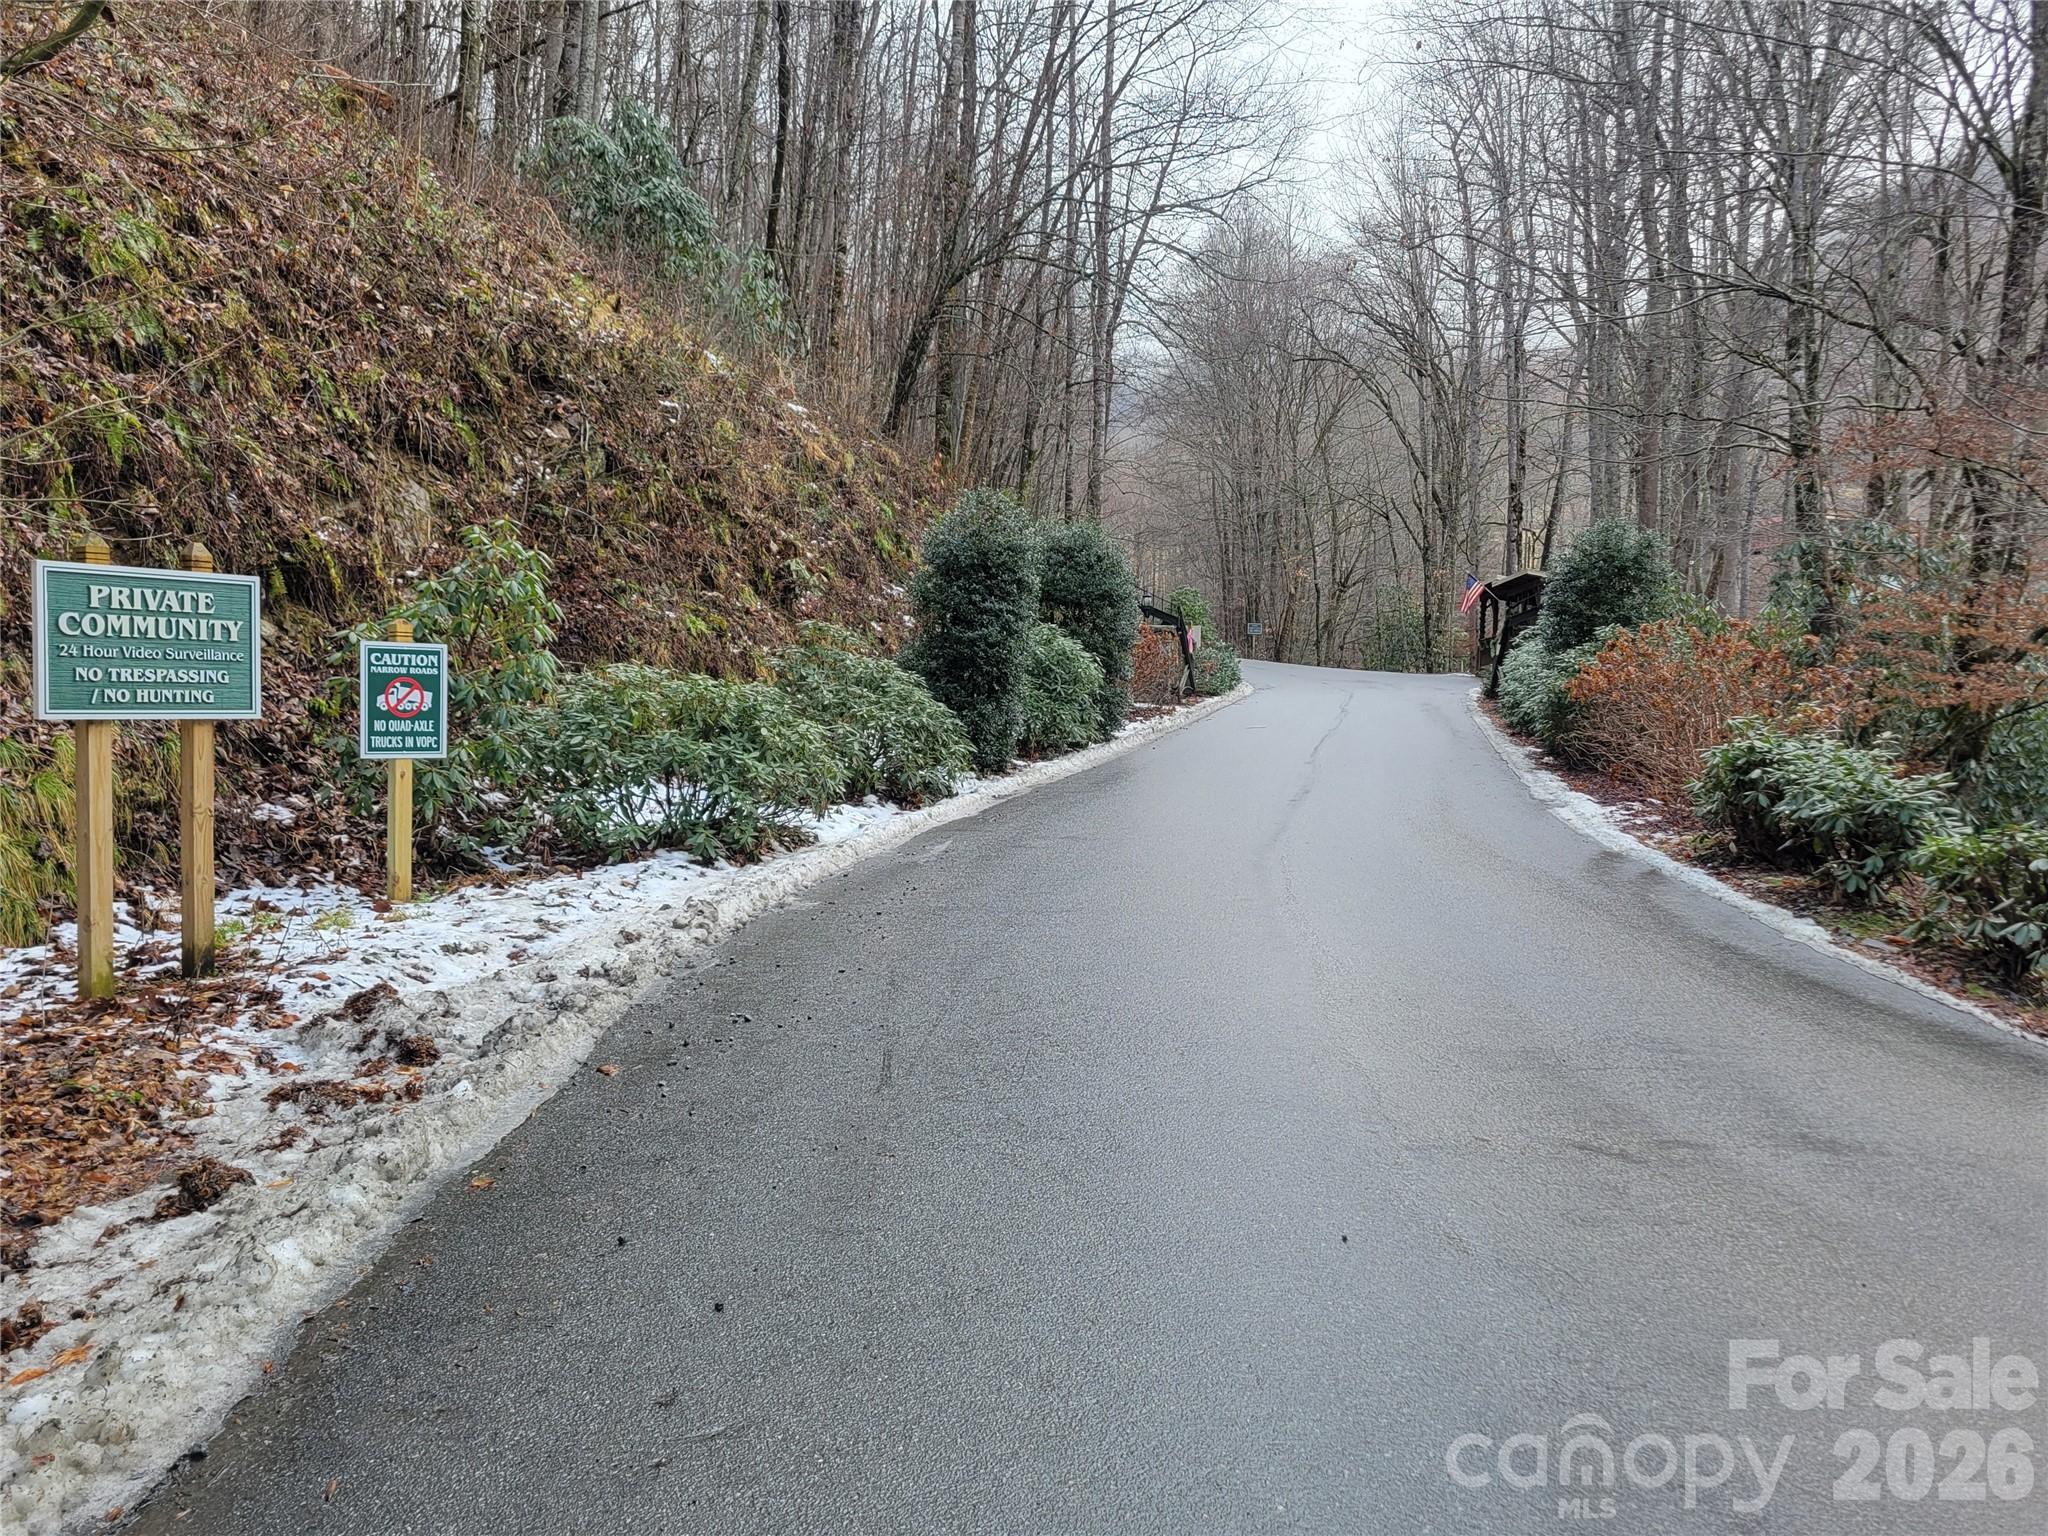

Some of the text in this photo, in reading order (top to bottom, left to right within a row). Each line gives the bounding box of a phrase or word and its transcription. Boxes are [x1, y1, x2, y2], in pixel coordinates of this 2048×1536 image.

[88, 585, 216, 614] PRIVATE
[58, 611, 243, 642] COMMUNITY
[58, 643, 244, 662] 24 Hour Video Surveillance
[370, 652, 438, 666] CAUTION
[75, 667, 230, 684] NO TRESPASSING
[370, 666, 438, 675] NARROW ROADS
[103, 688, 130, 703] NO
[136, 689, 215, 703] HUNTING
[374, 720, 434, 732] NO QUAD-AXLE
[370, 736, 438, 748] TRUCKS IN VOPC
